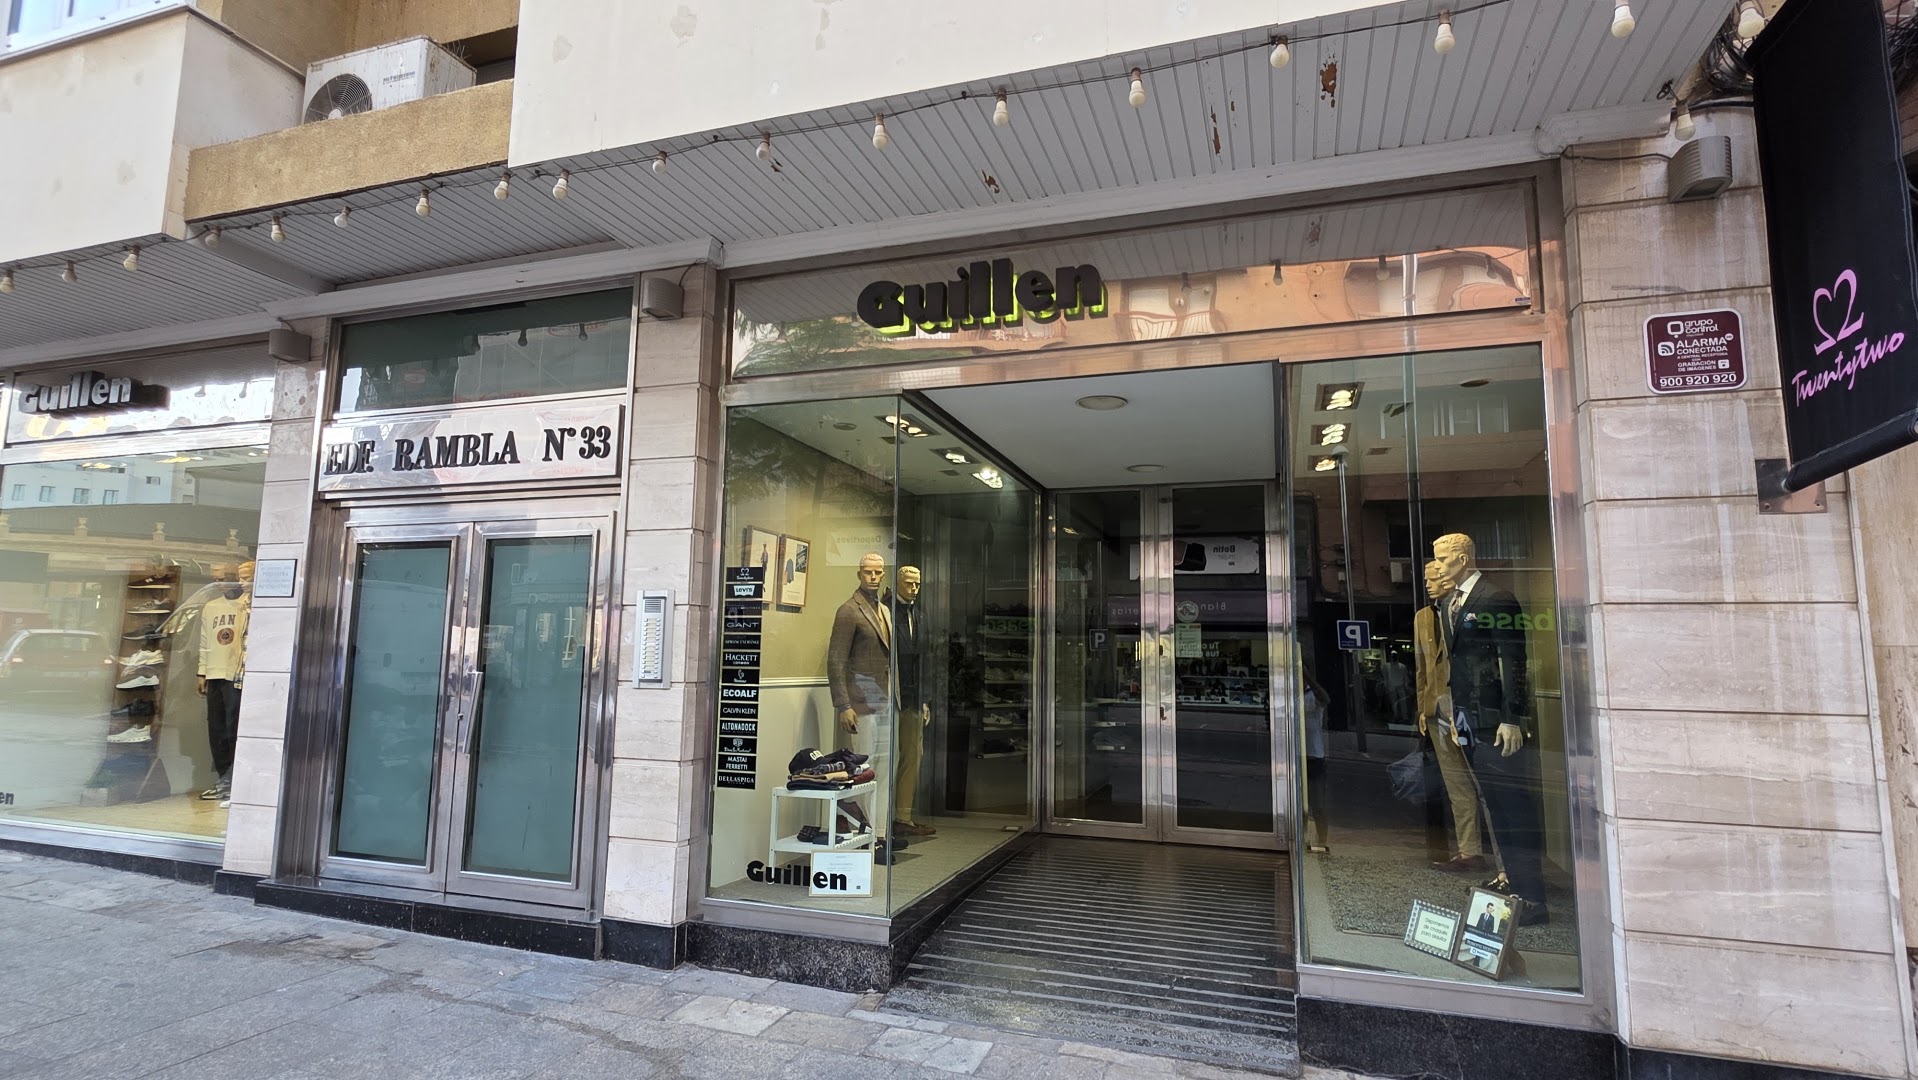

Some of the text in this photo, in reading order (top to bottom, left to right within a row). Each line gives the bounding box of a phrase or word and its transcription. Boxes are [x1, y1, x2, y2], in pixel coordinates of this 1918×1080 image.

[857, 257, 1107, 335] Guillen
[1685, 319, 1713, 328] grupo
[1685, 324, 1718, 334] control
[1676, 337, 1727, 349] ALARMA
[1676, 346, 1728, 355] CONECTADA
[1677, 360, 1716, 368] GRABACIÓN
[1791, 332, 1905, 407] Twentytwo
[1660, 373, 1737, 387] 900 920 920
[18, 371, 132, 413] Guillen
[323, 440, 375, 475] EDF.
[392, 431, 520, 471] RAMBLA
[212, 614, 237, 630] GAN
[725, 653, 758, 661] HACKETT
[723, 688, 757, 698] ECOALF
[741, 707, 756, 715] KLEIN
[721, 722, 756, 731] ALTONADOCK
[746, 860, 847, 891] Guillen
